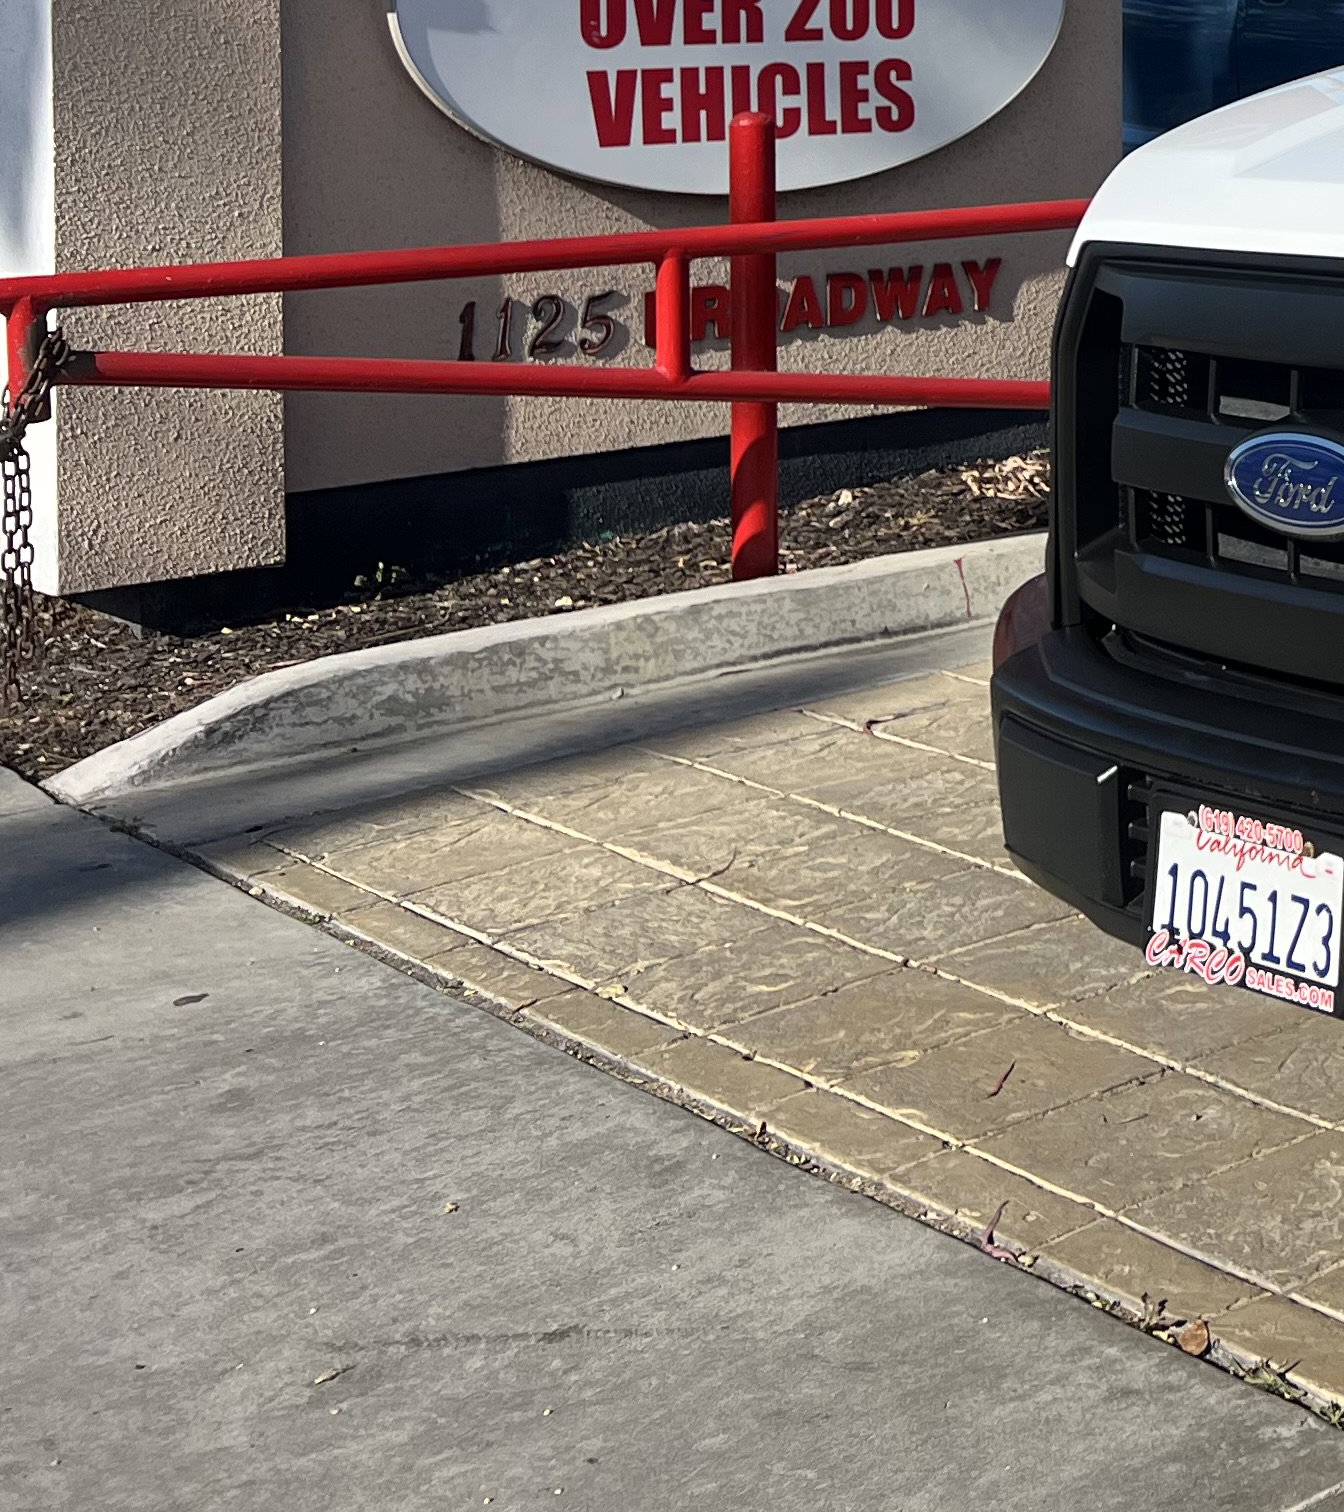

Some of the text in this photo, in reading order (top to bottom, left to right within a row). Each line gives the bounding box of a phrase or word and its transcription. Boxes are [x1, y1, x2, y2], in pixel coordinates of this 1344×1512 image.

[586, 58, 916, 148] VEHICLES
[457, 258, 1002, 362] 1125 RADWAY
[1253, 452, 1339, 514] Ford
[1196, 828, 1317, 878] California
[1199, 804, 1304, 855] (619) 420-5700
[1246, 966, 1336, 1014] SALES.COM
